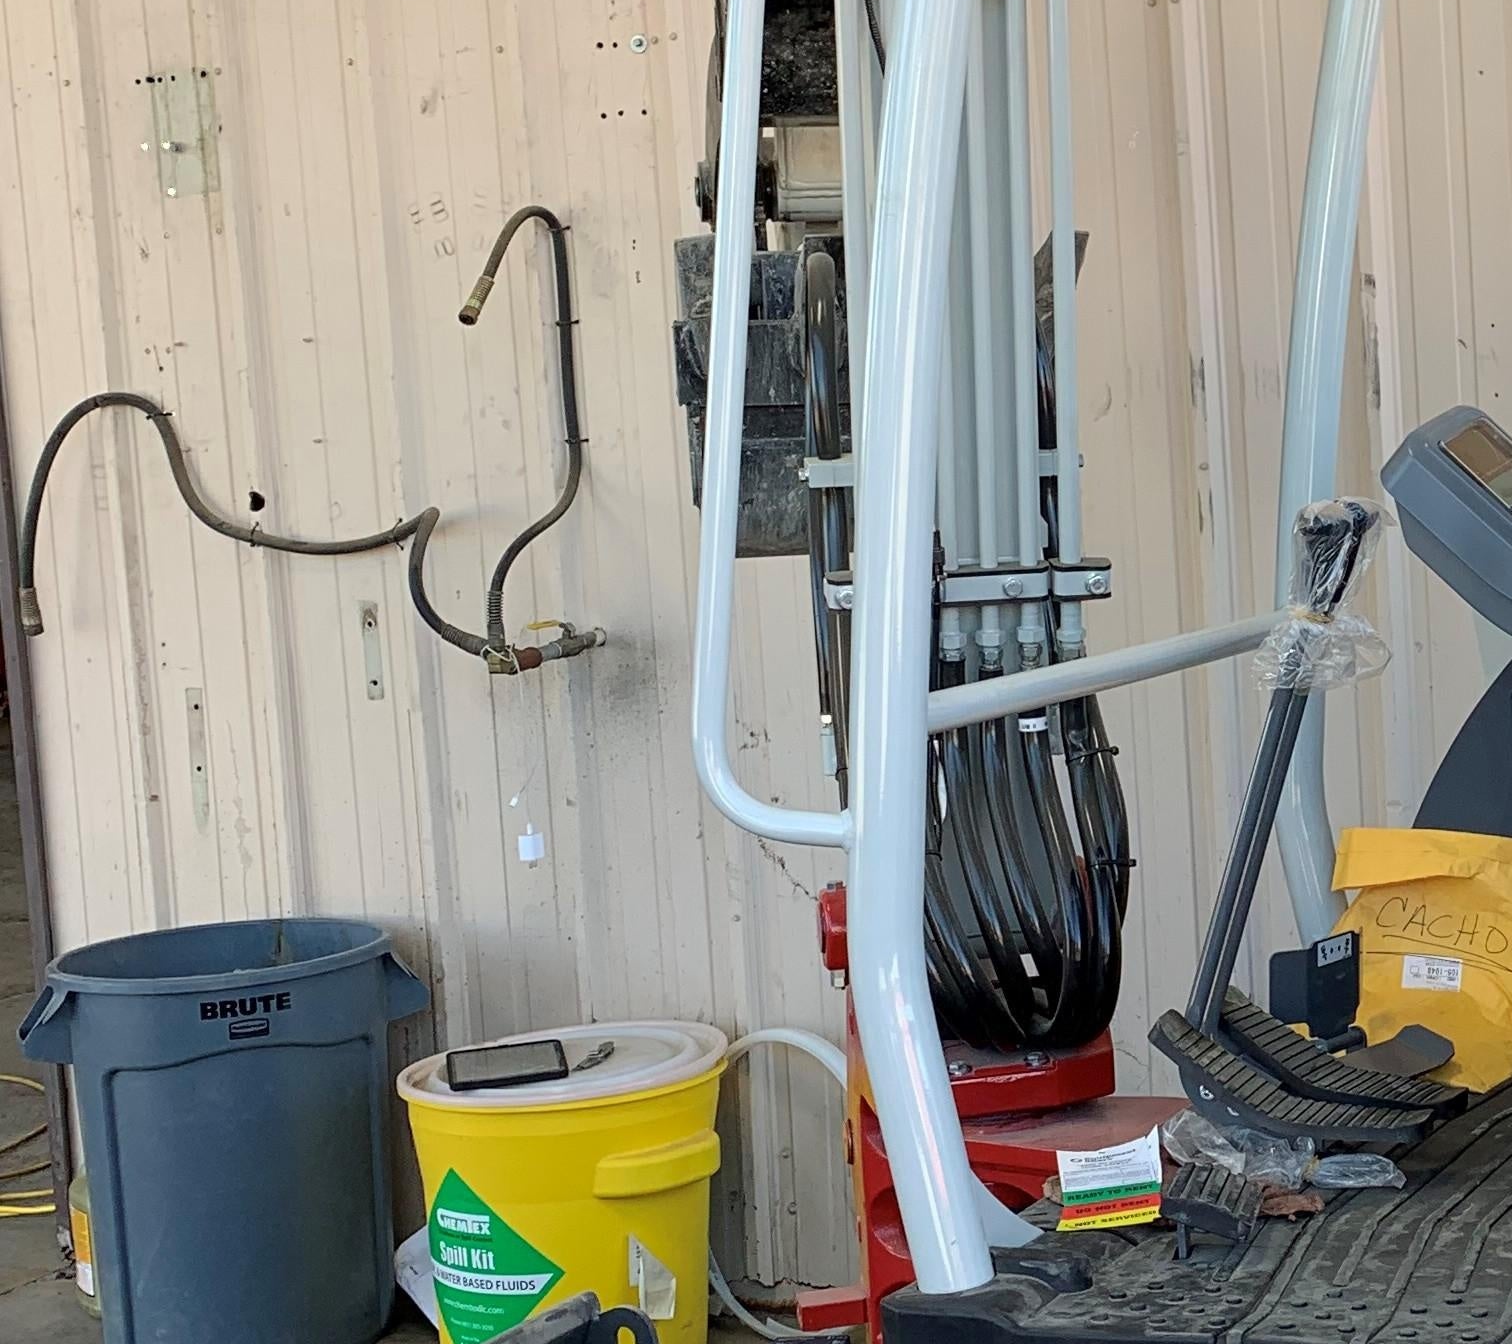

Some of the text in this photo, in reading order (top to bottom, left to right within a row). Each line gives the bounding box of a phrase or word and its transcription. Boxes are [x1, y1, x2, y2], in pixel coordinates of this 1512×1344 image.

[1375, 896, 1509, 954] CACHO
[199, 992, 292, 1021] BRUTE
[1067, 1191, 1105, 1202] READY
[439, 1240, 496, 1271] Spill Kit
[462, 1276, 494, 1290] BASED
[496, 1280, 537, 1291] FLUIDS
